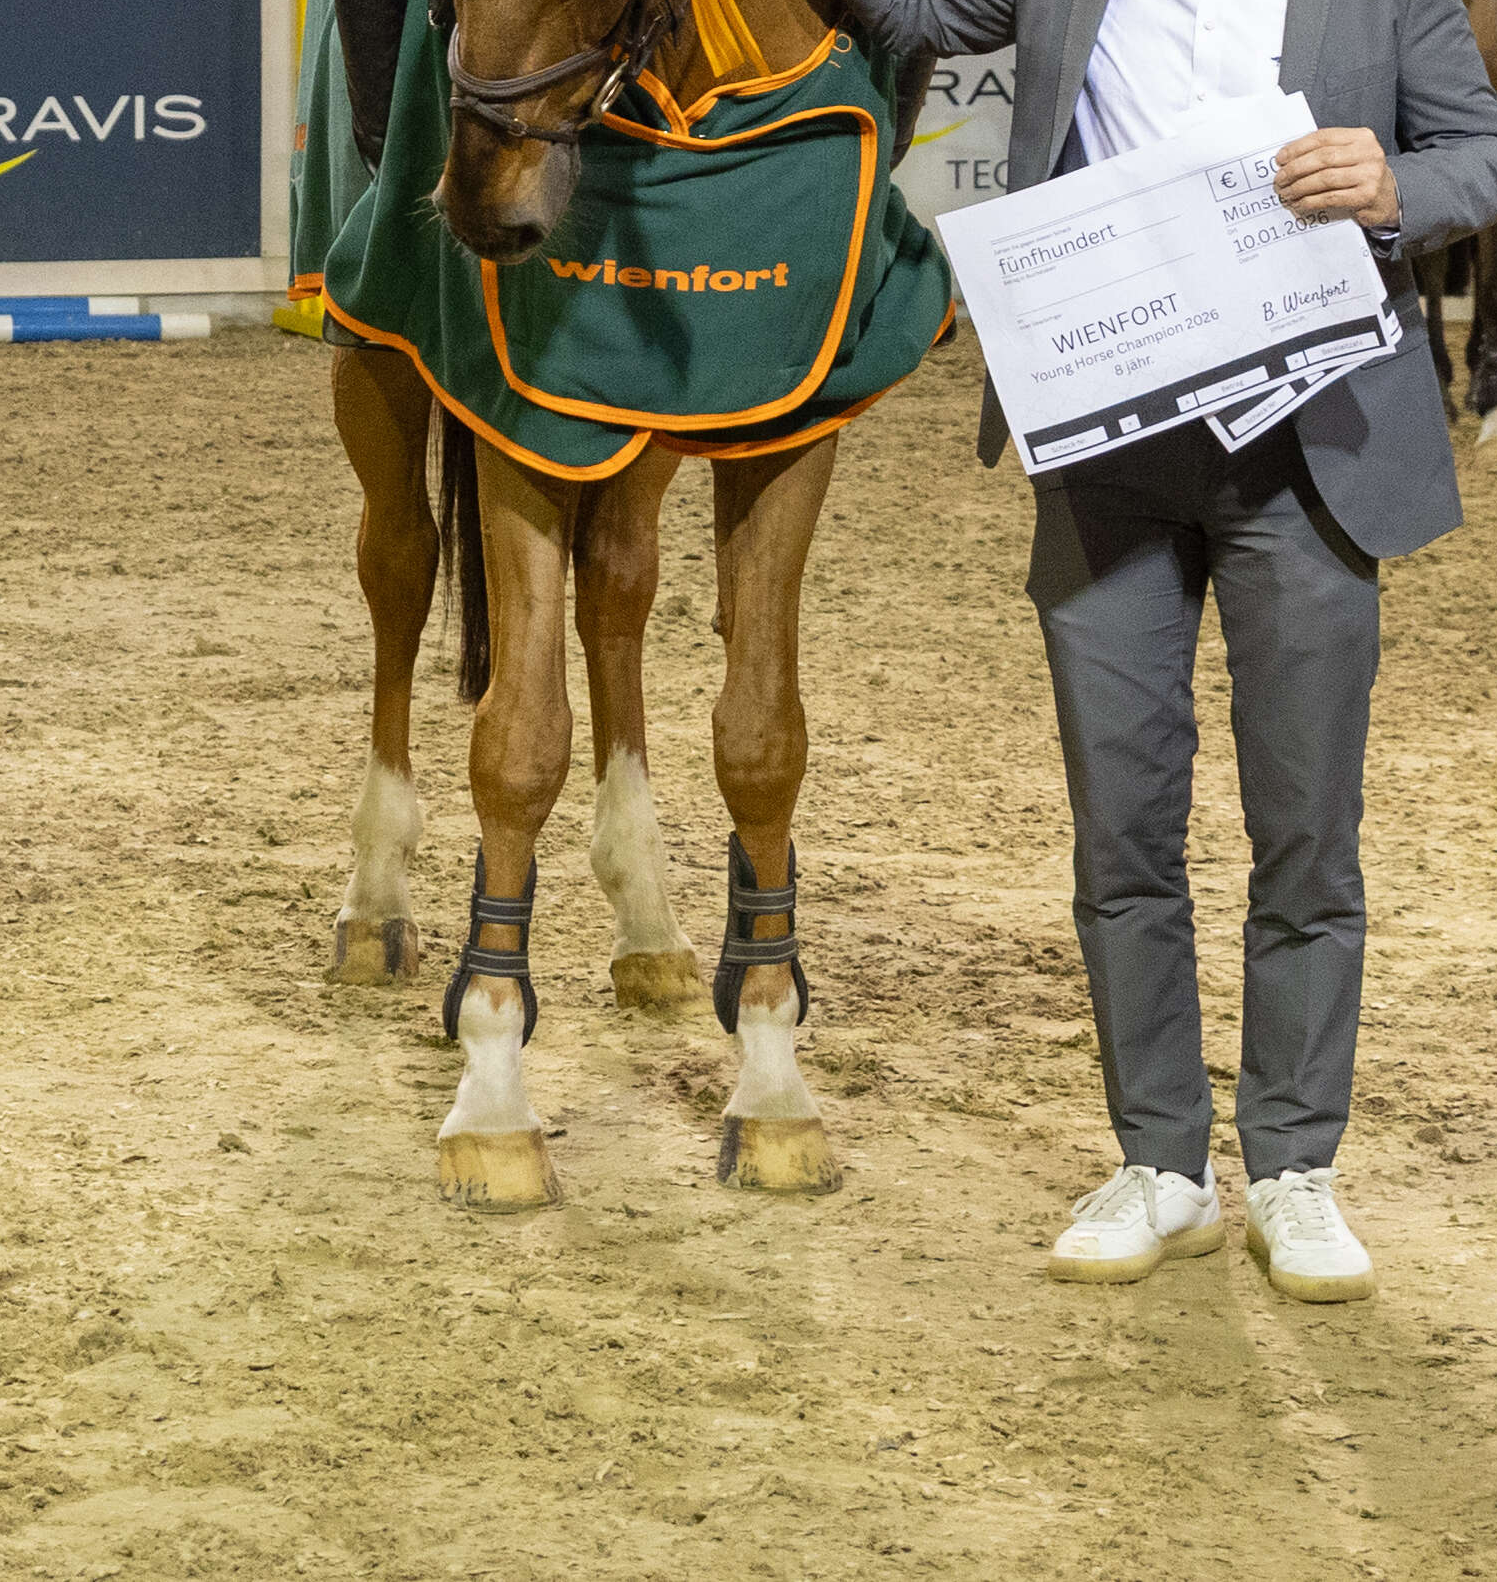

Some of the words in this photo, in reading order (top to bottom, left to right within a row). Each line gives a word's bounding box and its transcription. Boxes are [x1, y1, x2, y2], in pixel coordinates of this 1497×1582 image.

[1220, 171, 1238, 189] €
[1223, 193, 1289, 223] Münste
[998, 224, 1119, 275] fünfhundert
[1234, 210, 1330, 254] 10.01.2026
[548, 258, 790, 293] wienfort
[1262, 301, 1280, 322] B.
[1282, 279, 1351, 312] Wienfort
[1052, 292, 1180, 354] WIENFORT
[1031, 361, 1074, 384] Young
[1075, 349, 1115, 369] Horse
[1117, 325, 1185, 356] Champion
[1186, 308, 1220, 329] 2026
[1114, 364, 1124, 377] 8
